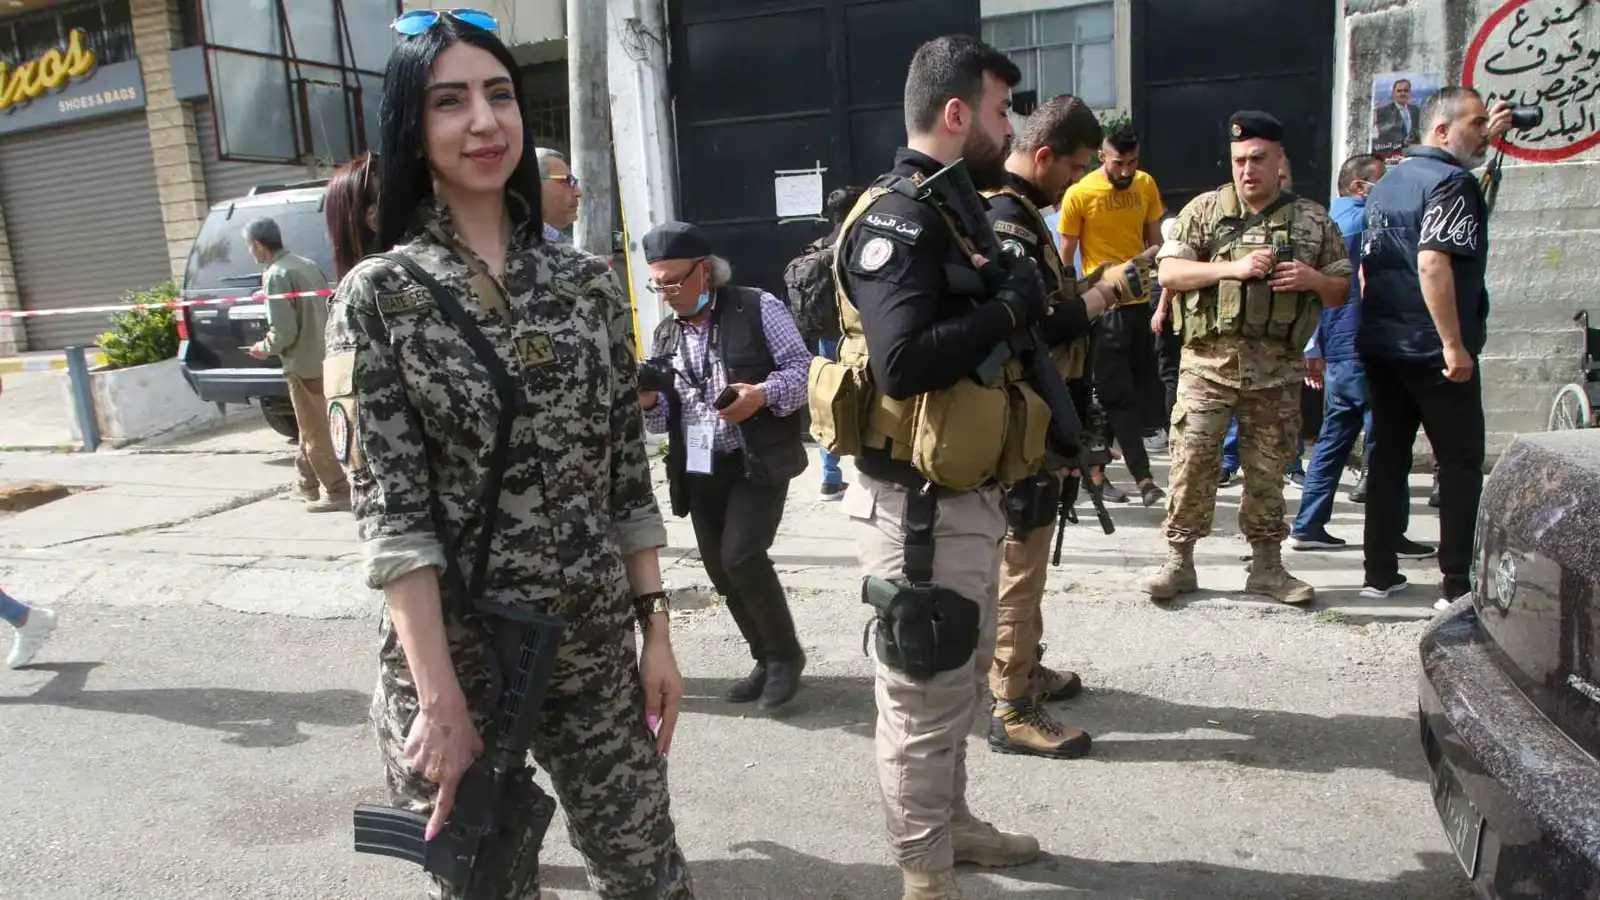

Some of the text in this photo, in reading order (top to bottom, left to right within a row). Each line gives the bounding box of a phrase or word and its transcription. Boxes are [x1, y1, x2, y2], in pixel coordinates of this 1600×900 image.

[1508, 0, 1589, 48] منوع
[1097, 191, 1142, 212] FUSION
[525, 339, 550, 361] A+
